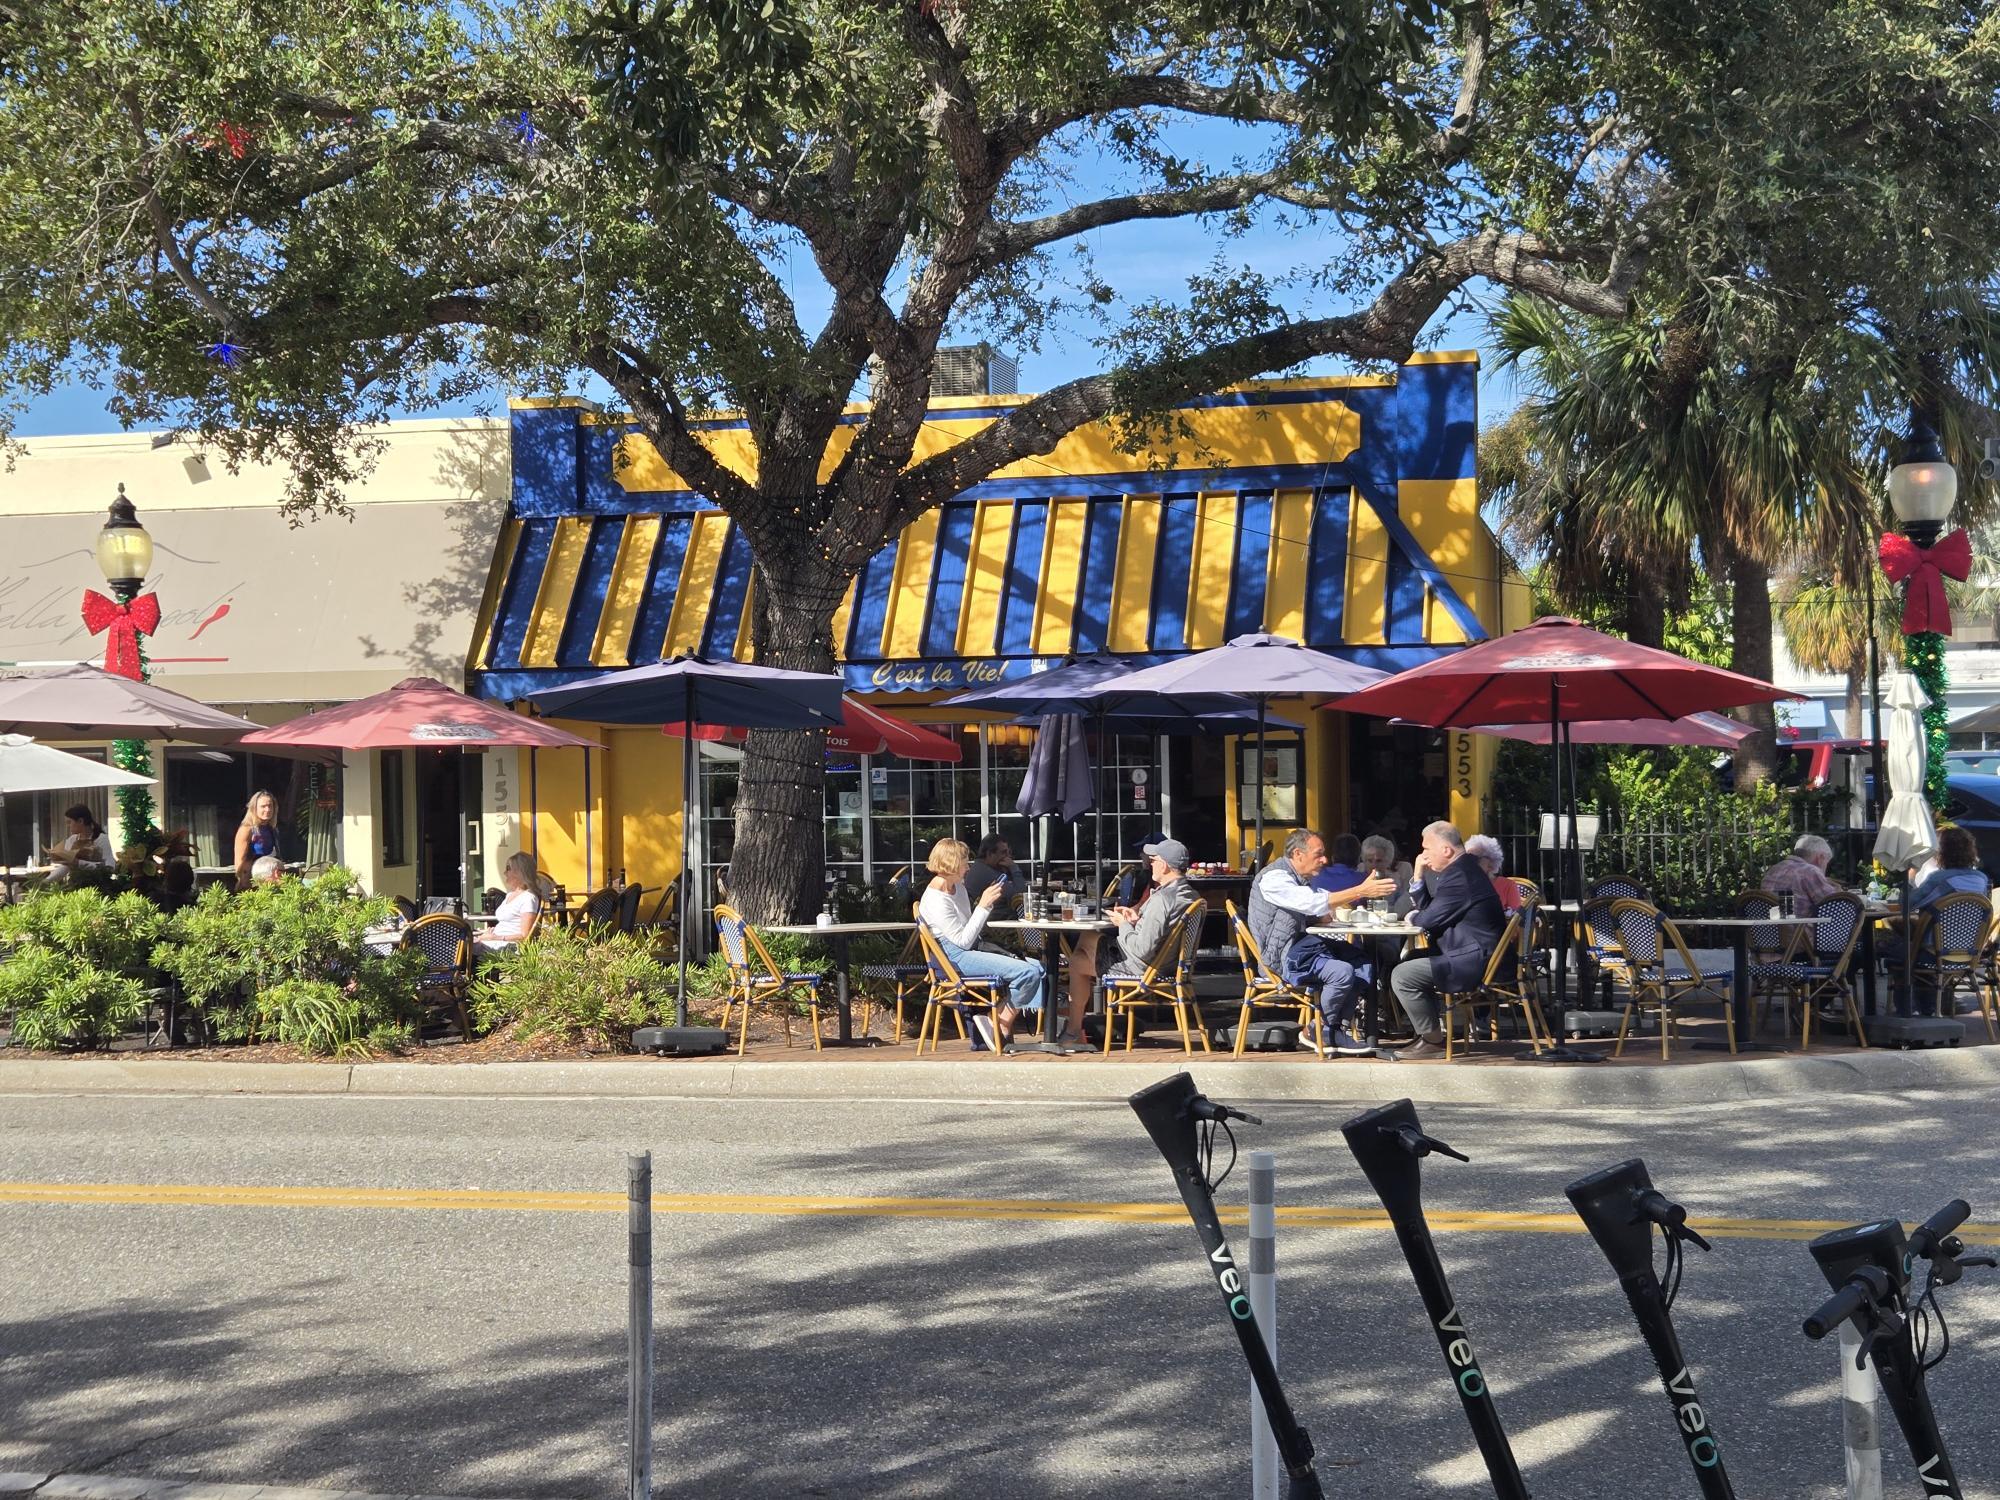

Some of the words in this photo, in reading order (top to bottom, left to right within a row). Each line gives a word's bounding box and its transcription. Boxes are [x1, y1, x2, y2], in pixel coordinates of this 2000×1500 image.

[872, 661, 926, 686] C'est
[931, 663, 955, 683] la
[961, 660, 1010, 683] Vie!
[495, 758, 508, 848] 1551
[1211, 1241, 1252, 1320] veo
[1439, 1305, 1485, 1397] veo
[1669, 1366, 1718, 1468] veo
